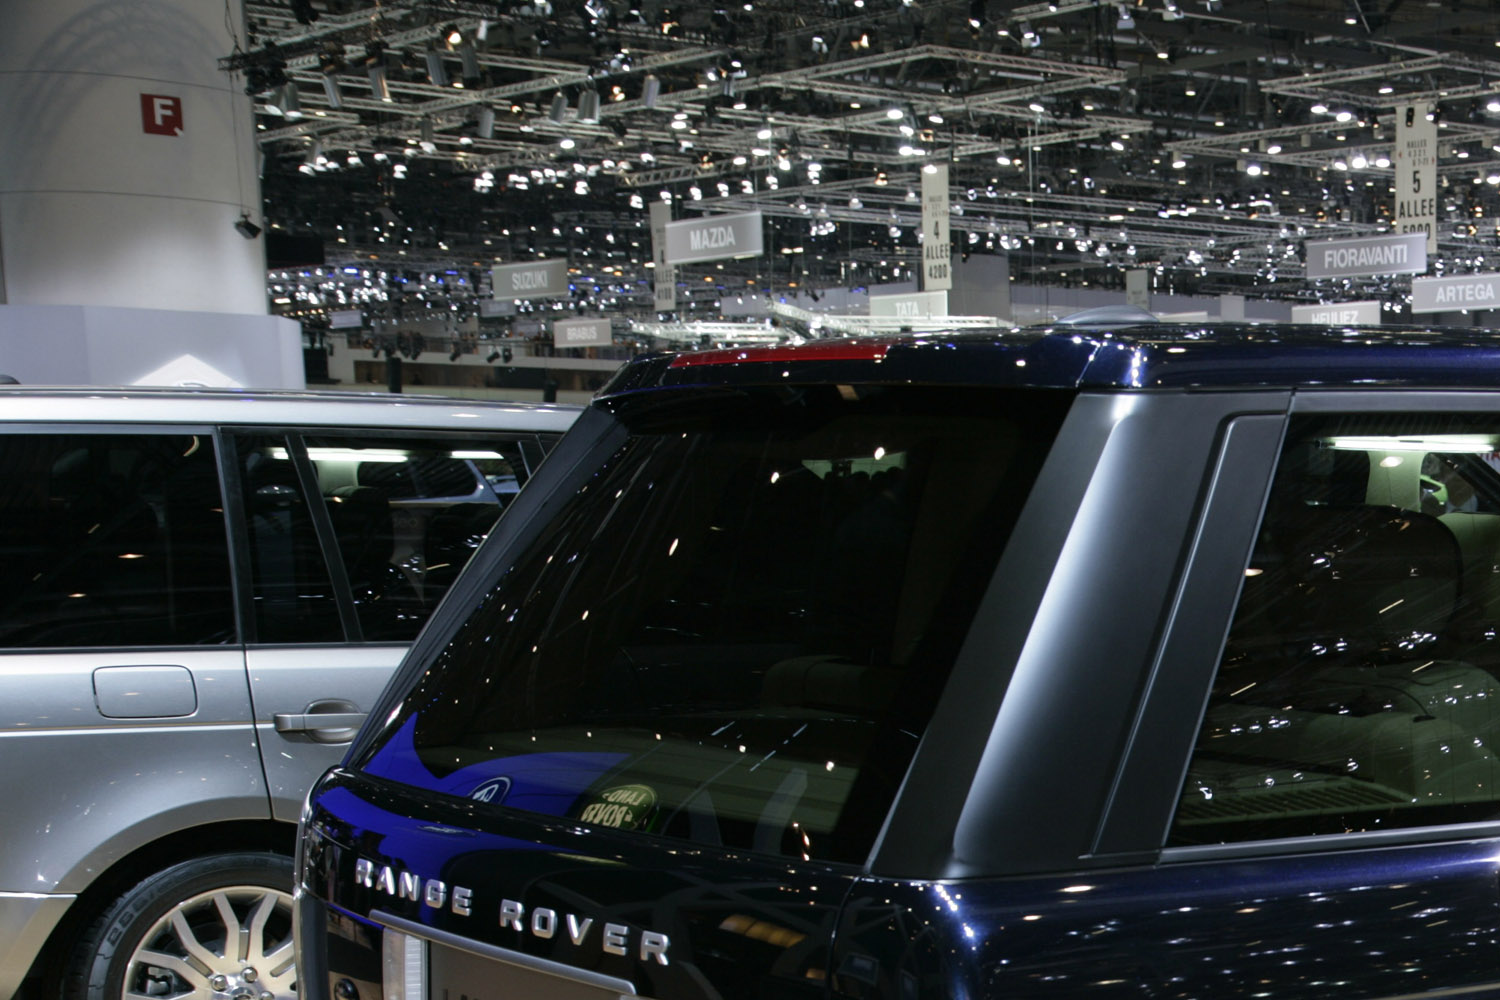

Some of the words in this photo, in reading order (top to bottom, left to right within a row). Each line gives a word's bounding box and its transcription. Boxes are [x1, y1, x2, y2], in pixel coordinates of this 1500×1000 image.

[153, 98, 174, 126] F
[1413, 171, 1420, 193] 5
[1399, 199, 1434, 218] ALLEE
[690, 226, 736, 251] MAZDA
[926, 244, 949, 260] ALLEE
[1325, 244, 1408, 269] FIORAVANTI
[512, 270, 548, 290] SUZUKI
[1436, 284, 1495, 303] ARTEGA
[895, 302, 920, 316] TATA
[567, 326, 597, 340] BRABUS
[355, 858, 473, 916] RANGE
[500, 899, 671, 966] ROVER
